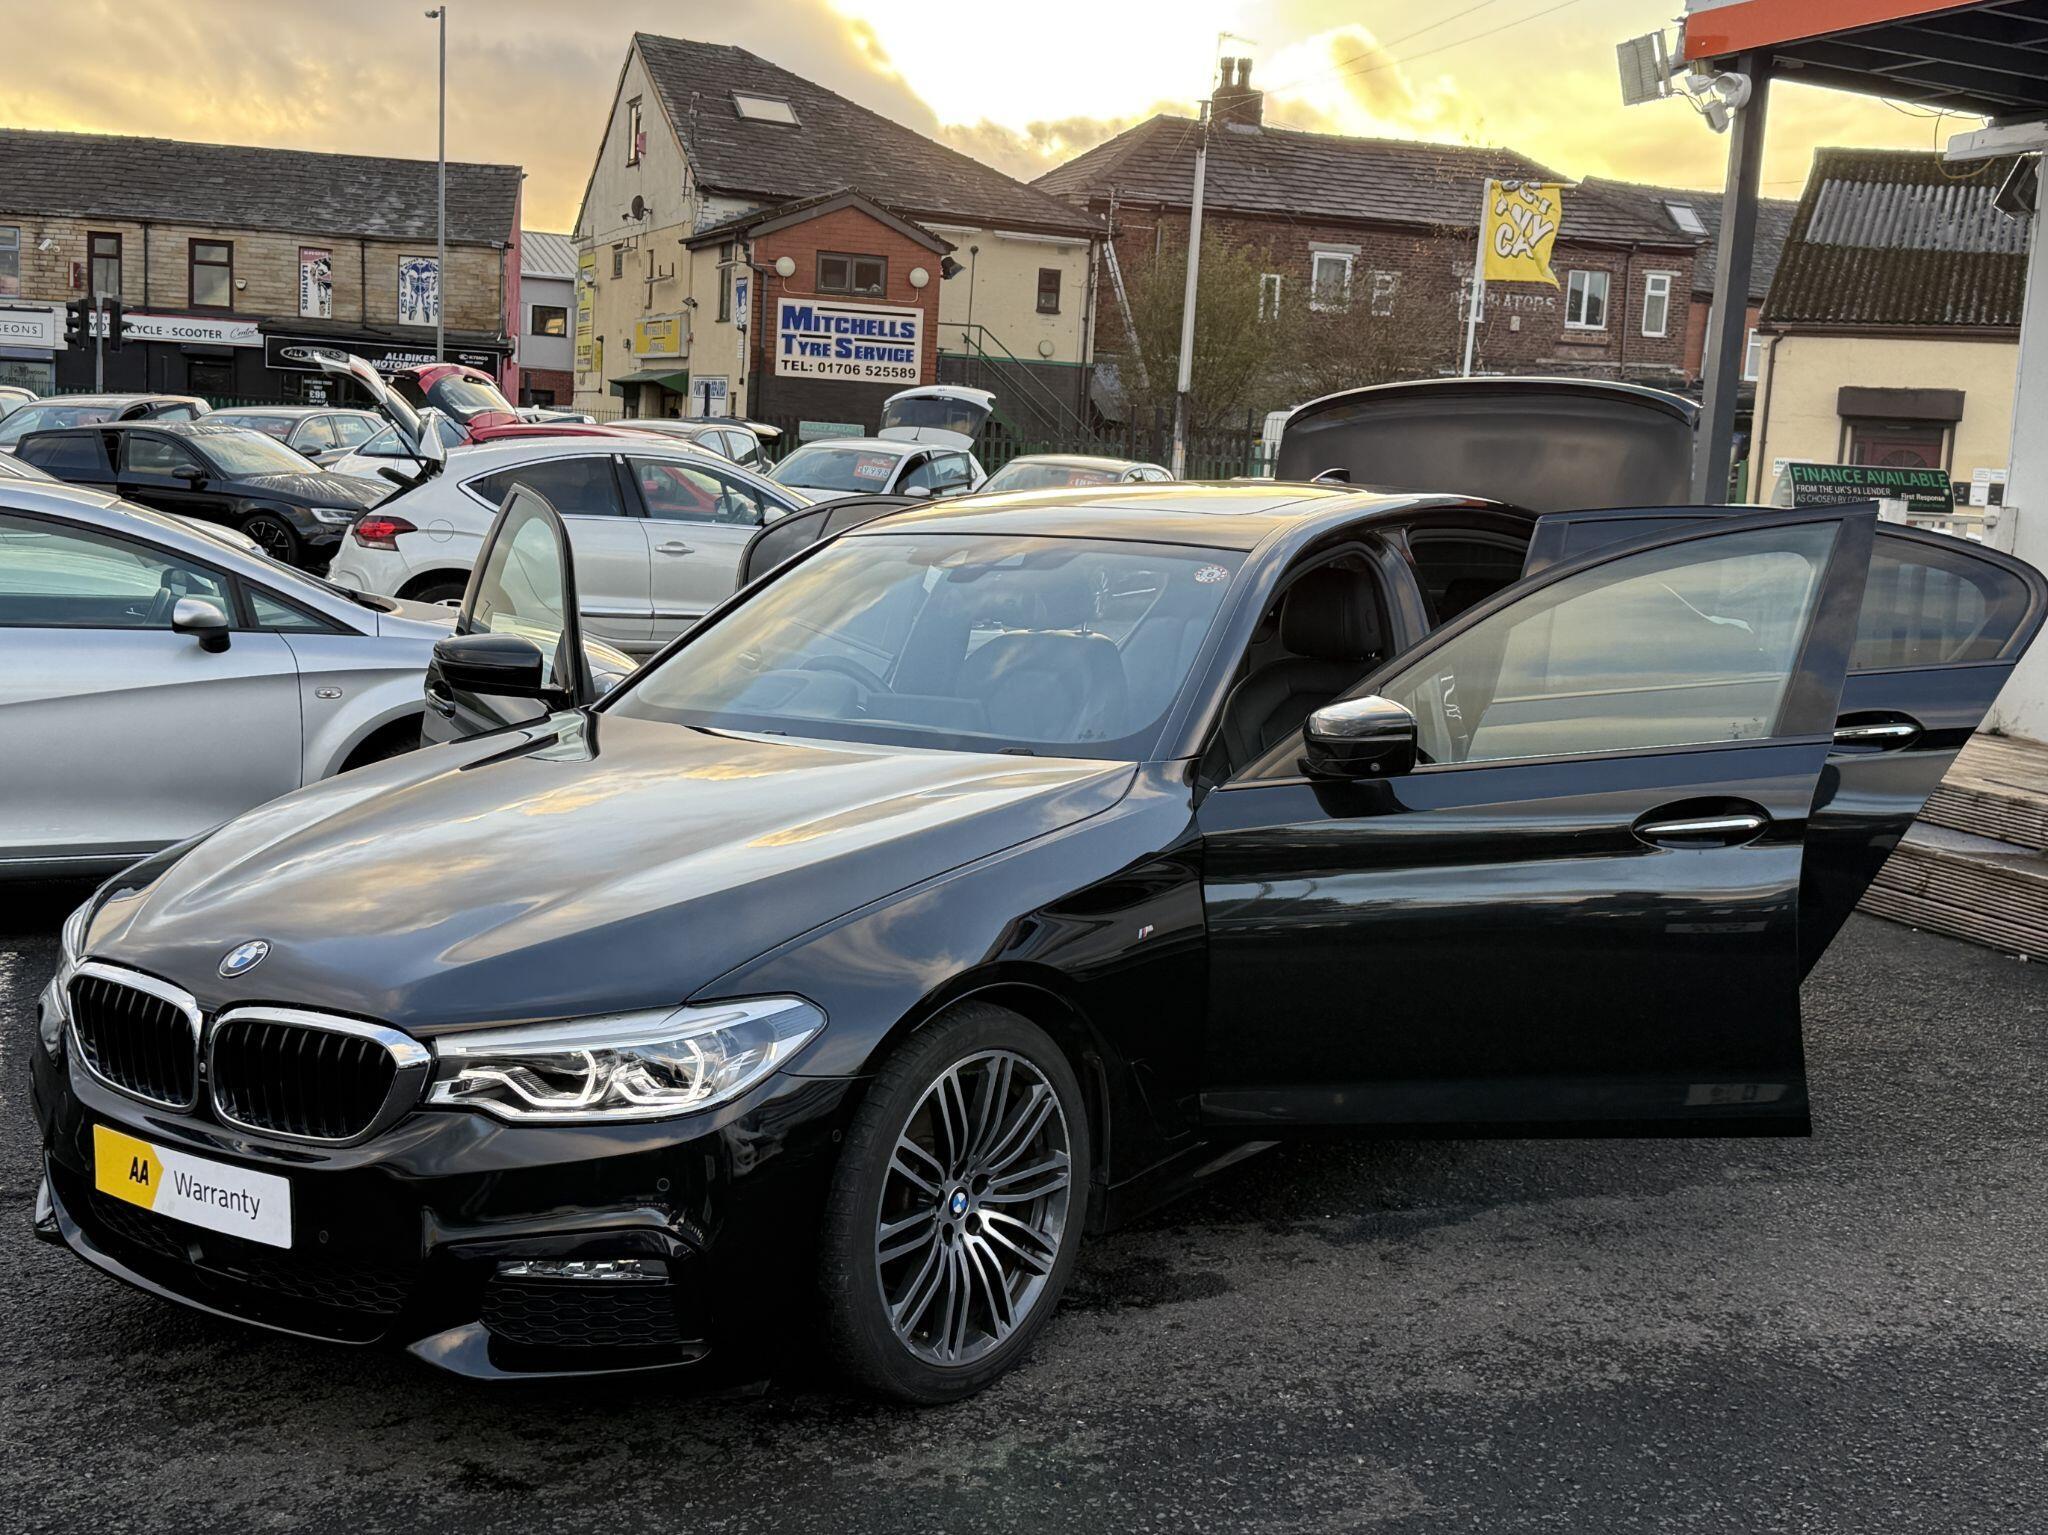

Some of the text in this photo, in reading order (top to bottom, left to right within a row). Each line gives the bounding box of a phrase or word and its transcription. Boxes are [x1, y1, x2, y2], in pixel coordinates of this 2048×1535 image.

[301, 265, 309, 311] LEATHERS
[782, 305, 915, 339] MITCHELLS
[0, 324, 38, 335] EONS
[172, 327, 222, 339] SCOOTER
[288, 349, 304, 357] ALL
[781, 333, 914, 363] TYRE SERVICE
[384, 352, 437, 363] ALLBIKES
[781, 360, 917, 379] TEL: 01706 525589
[1793, 466, 1865, 484] FINANCE
[1867, 470, 1948, 488] AVAILABLE
[1796, 484, 1818, 493] FROM
[1818, 484, 1834, 493] THE
[1834, 485, 1852, 494] UK'S
[1861, 487, 1891, 496] LENDER
[1796, 494, 1806, 503] AS
[1806, 494, 1837, 504] CHOSEN
[1837, 496, 1847, 504] BY
[1901, 492, 1946, 502] First Response
[129, 1156, 261, 1220] AA Warranty
